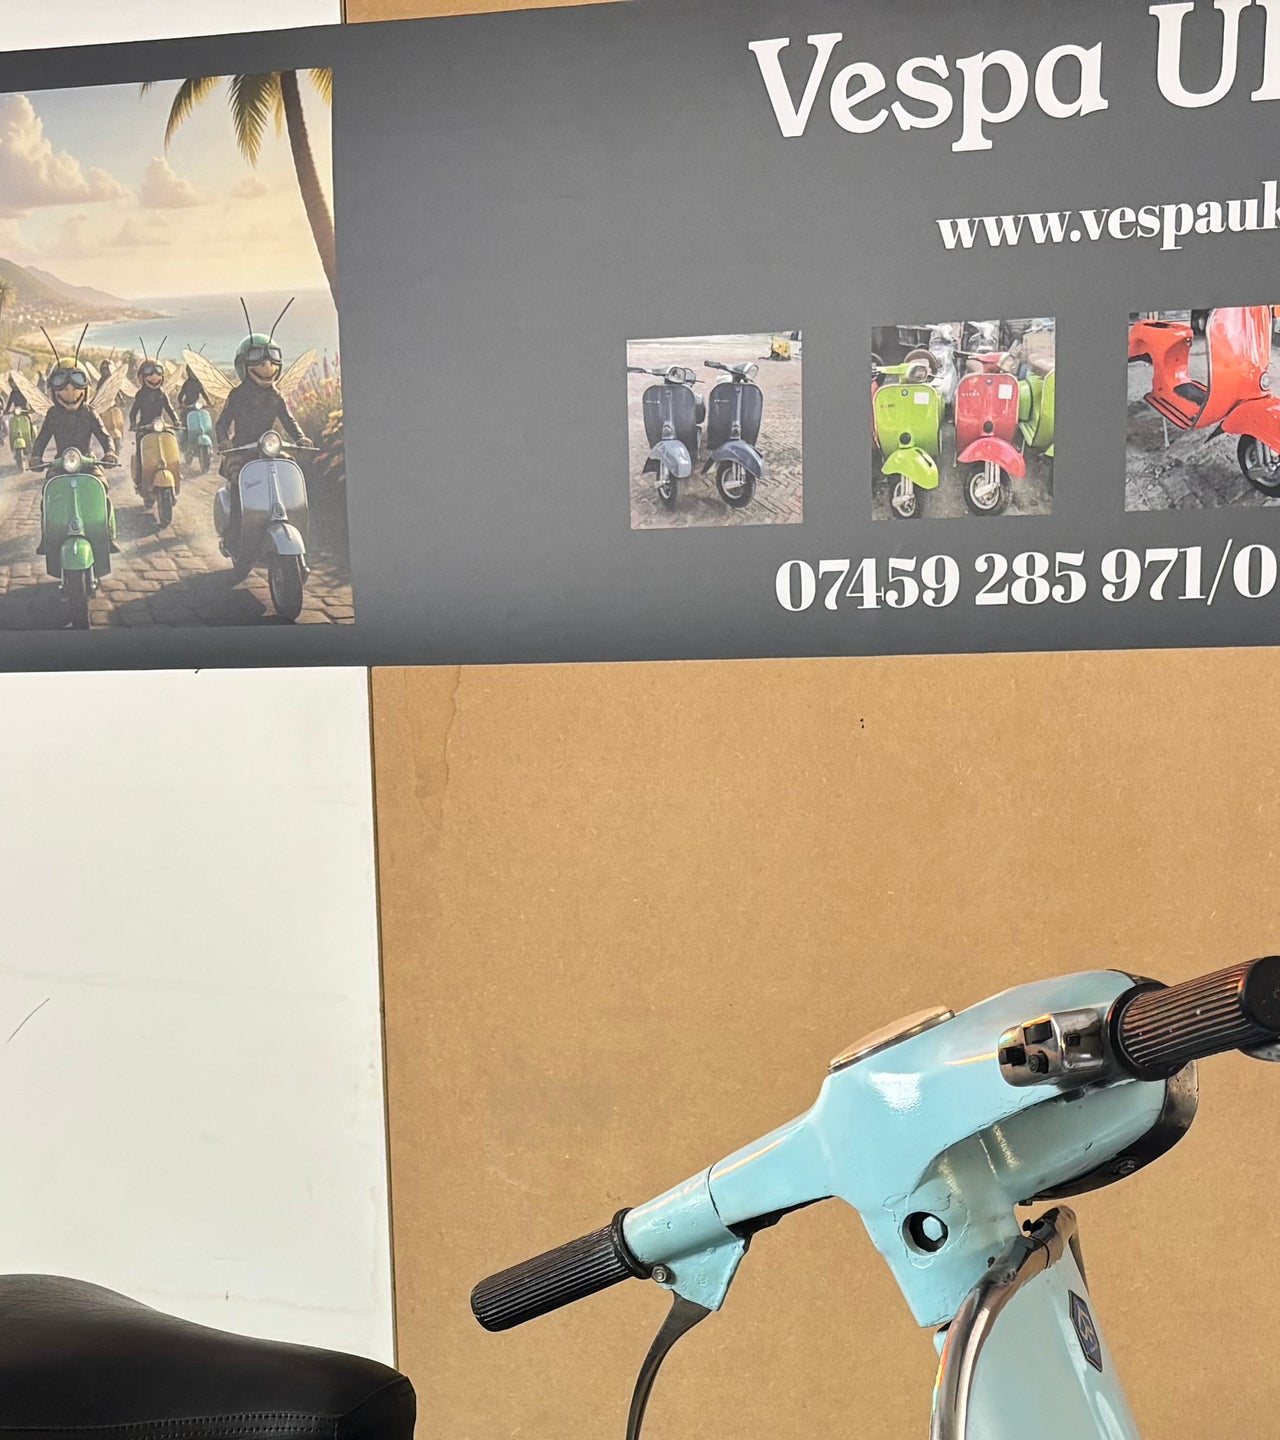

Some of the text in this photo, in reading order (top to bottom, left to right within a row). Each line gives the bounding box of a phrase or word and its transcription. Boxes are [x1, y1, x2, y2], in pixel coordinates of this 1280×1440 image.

[747, 32, 1110, 153] Vespa
[775, 554, 960, 612] 07459
[974, 550, 1087, 606] 285
